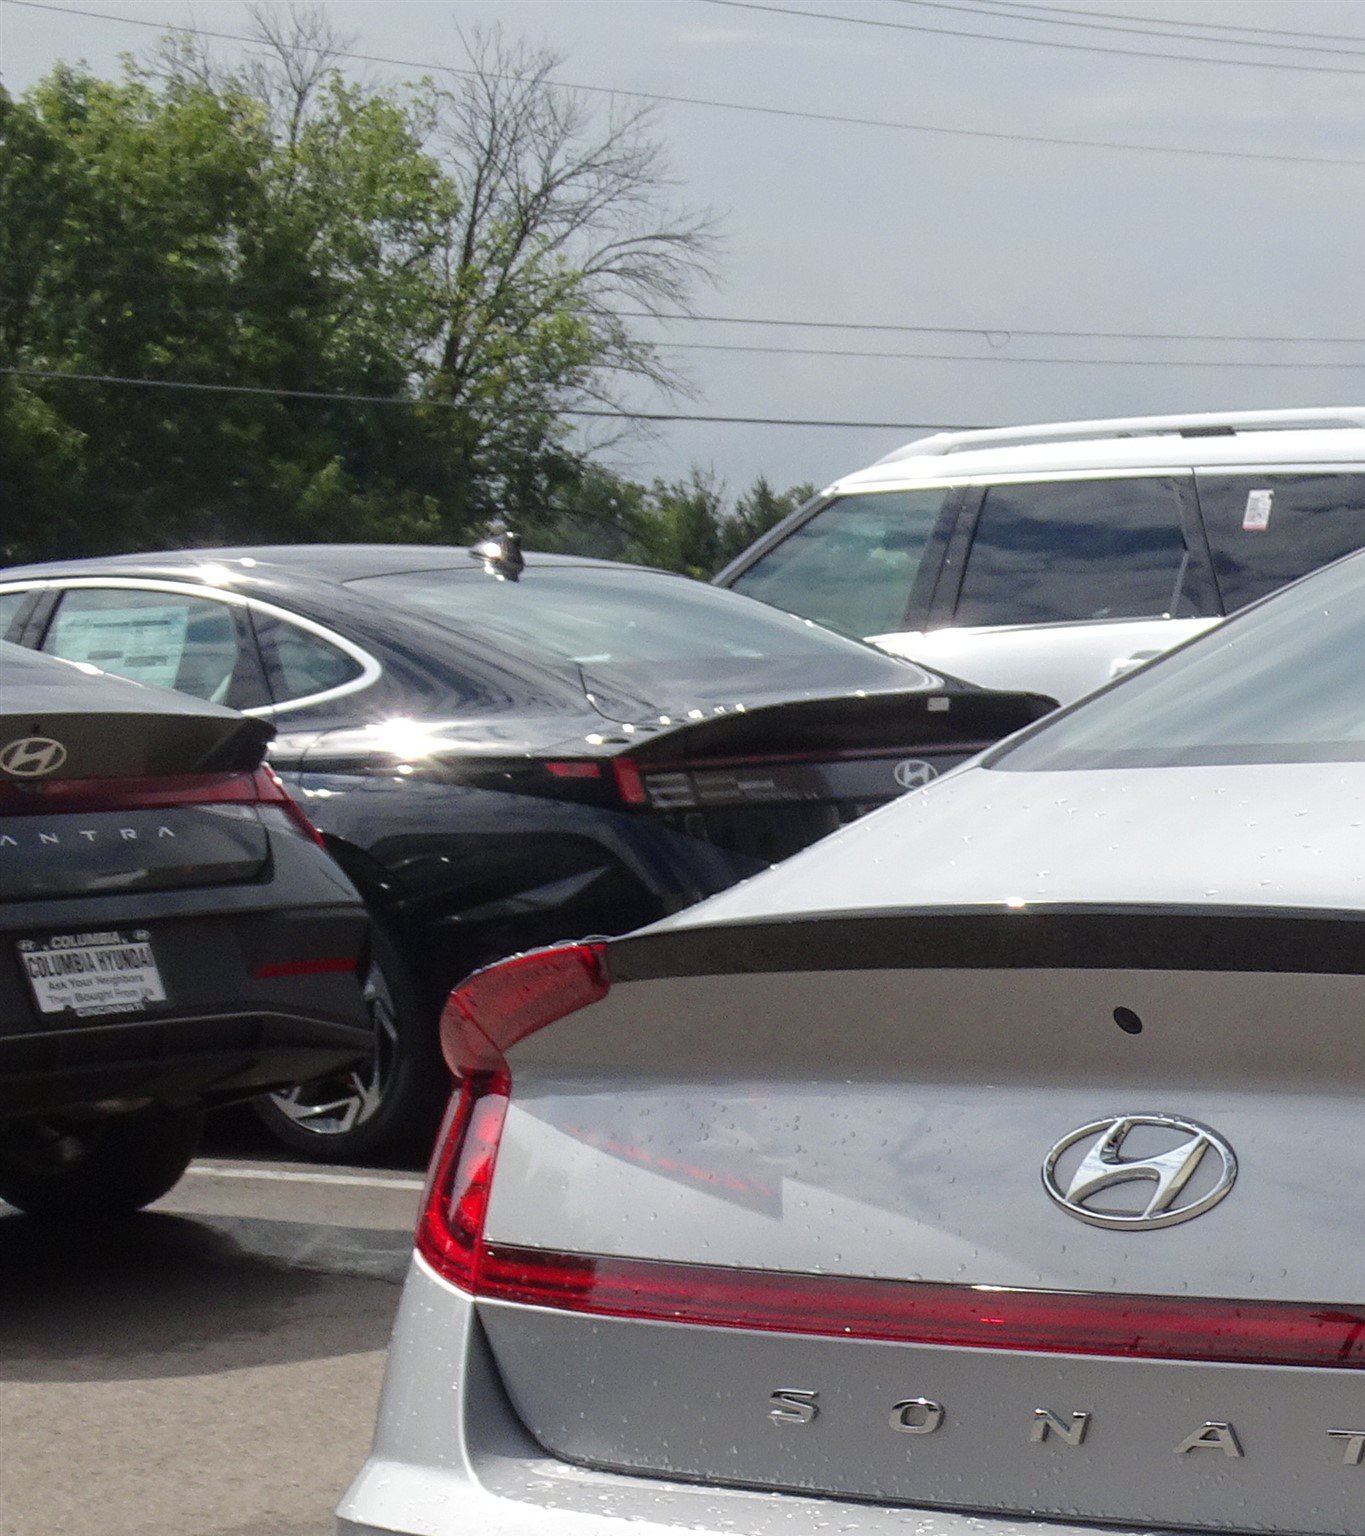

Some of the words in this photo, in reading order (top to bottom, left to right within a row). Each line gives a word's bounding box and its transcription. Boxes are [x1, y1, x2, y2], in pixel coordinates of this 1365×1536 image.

[50, 931, 121, 949] COLUMBIA
[27, 951, 97, 978] COLUMBIA
[96, 946, 157, 972] HYUNDAI
[48, 979, 68, 991] Ask
[68, 977, 94, 988] Your
[95, 974, 145, 987] Neighbors
[74, 990, 113, 1004] Bought
[113, 988, 139, 999] From
